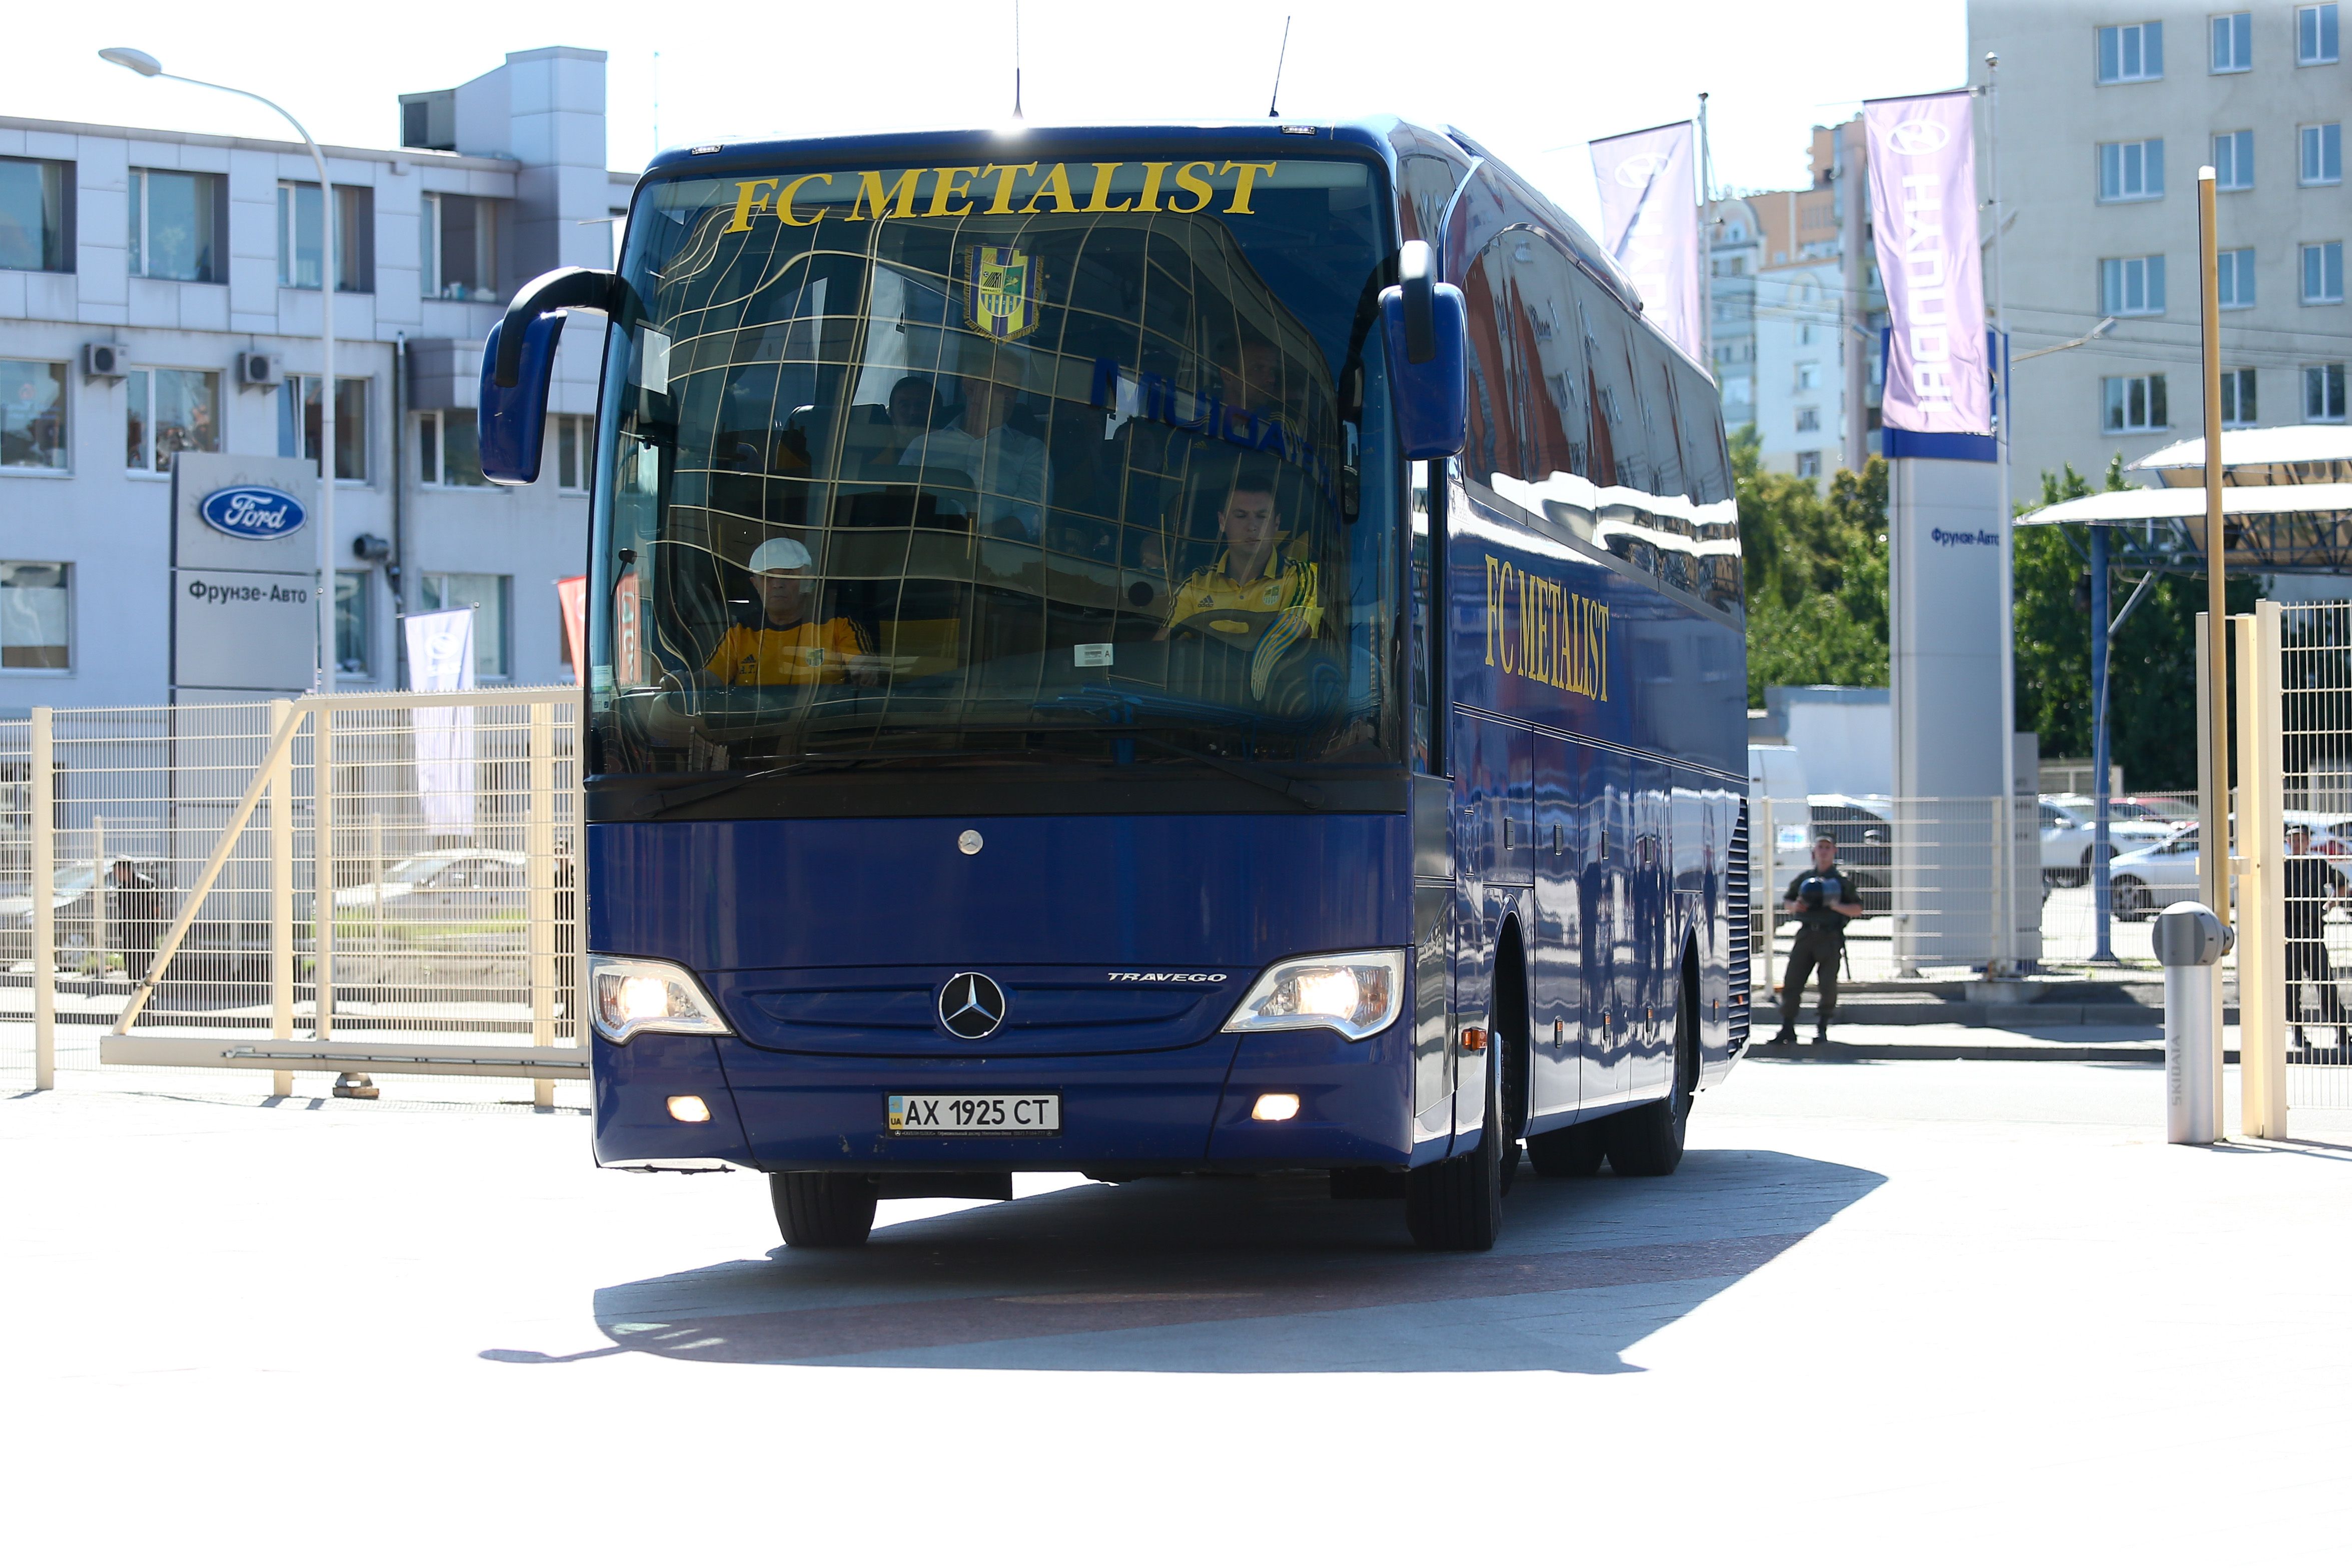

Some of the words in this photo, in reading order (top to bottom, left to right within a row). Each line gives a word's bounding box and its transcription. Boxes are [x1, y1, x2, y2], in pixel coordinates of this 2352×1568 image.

[724, 173, 832, 234] FC
[844, 160, 1277, 222] METALIST
[224, 493, 288, 529] Ford
[189, 580, 307, 604] Фрунзе-Авто
[1485, 553, 1513, 674] FC
[1518, 569, 1609, 702] METALIST
[1108, 973, 1228, 982] TRAVEGO
[2171, 1035, 2181, 1106] SKIDATA
[905, 1100, 939, 1125] AX
[949, 1100, 1005, 1125] 1925
[1014, 1099, 1049, 1125] CT
